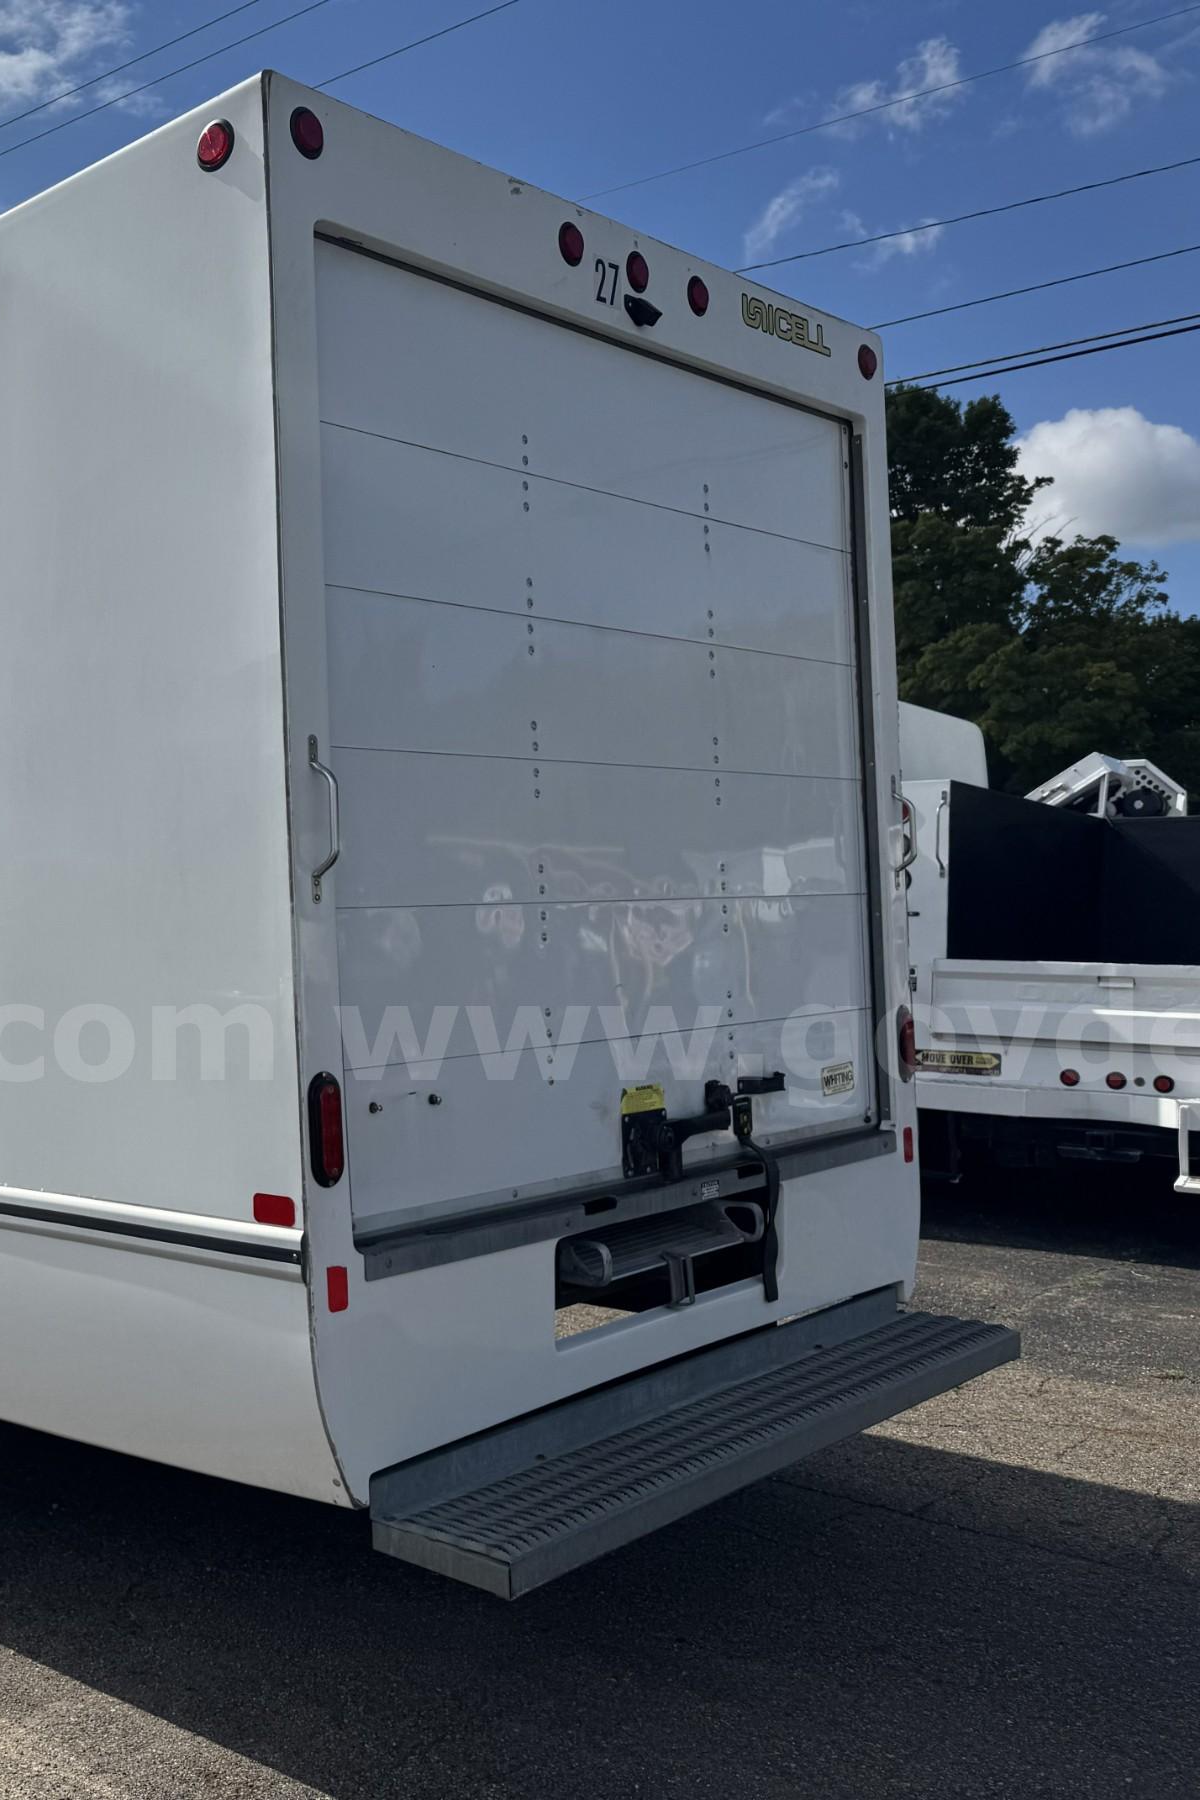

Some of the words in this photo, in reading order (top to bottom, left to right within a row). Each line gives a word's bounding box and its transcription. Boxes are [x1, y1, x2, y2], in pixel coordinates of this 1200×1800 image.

[594, 257, 619, 306] 27
[741, 293, 832, 358] UNICELL
[921, 1050, 946, 1064] MOVE
[950, 1054, 974, 1066] OVER
